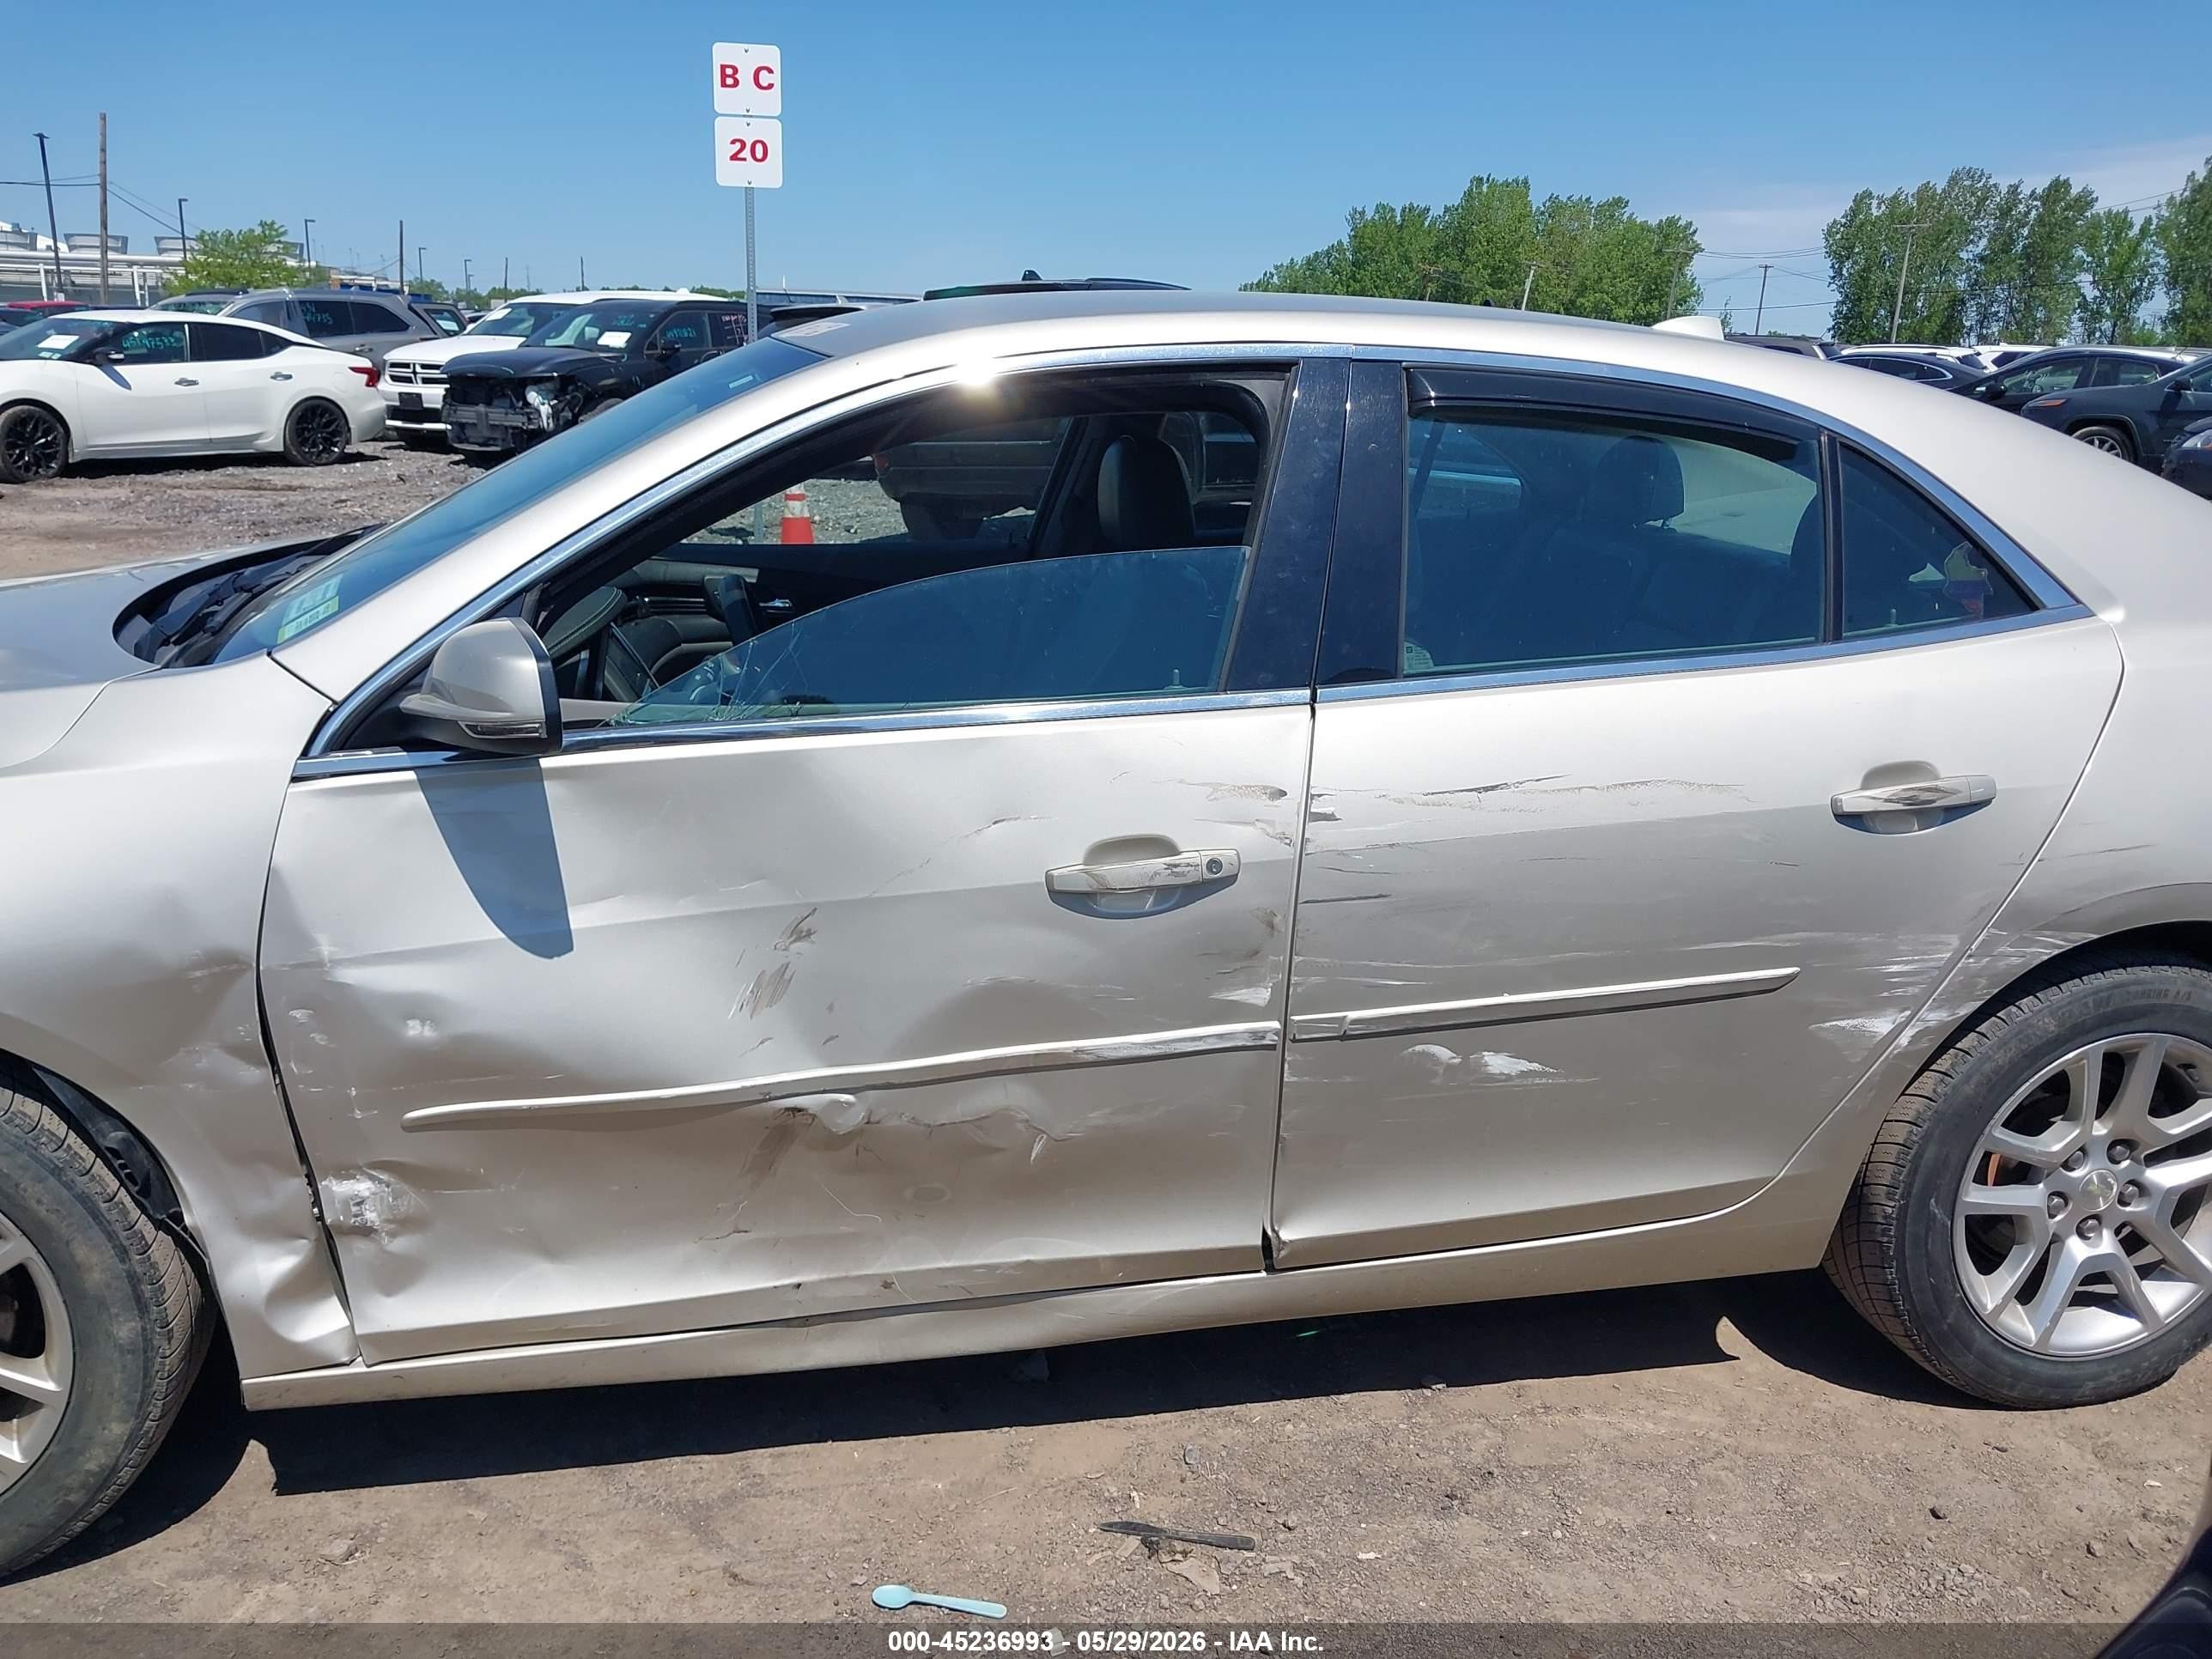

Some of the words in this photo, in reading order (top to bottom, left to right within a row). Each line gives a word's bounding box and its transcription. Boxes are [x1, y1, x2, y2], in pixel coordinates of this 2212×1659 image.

[720, 64, 740, 88] B
[752, 65, 775, 90] C
[729, 138, 769, 162] 20
